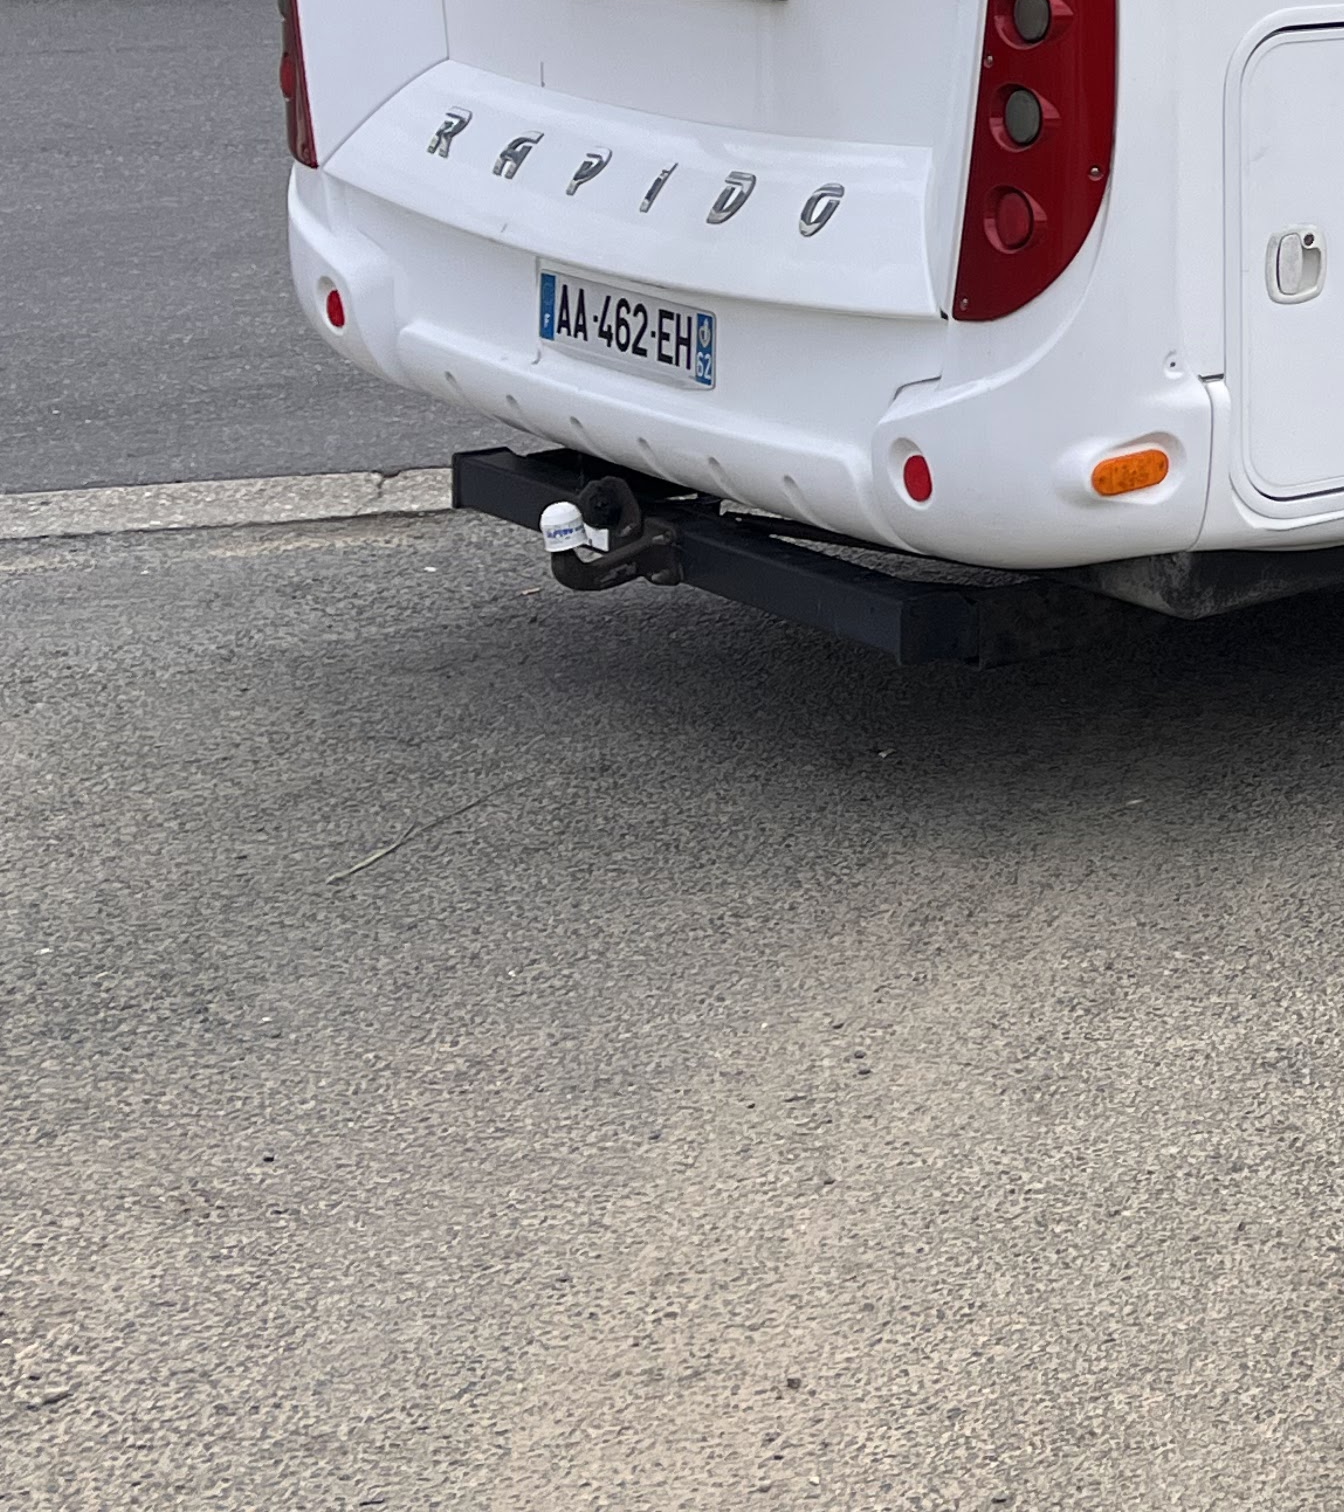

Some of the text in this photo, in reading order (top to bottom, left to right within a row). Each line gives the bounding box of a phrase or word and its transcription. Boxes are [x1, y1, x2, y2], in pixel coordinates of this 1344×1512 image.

[427, 106, 845, 237] RAPIDO
[556, 284, 693, 370] AA-462-EH
[696, 351, 712, 380] 62
